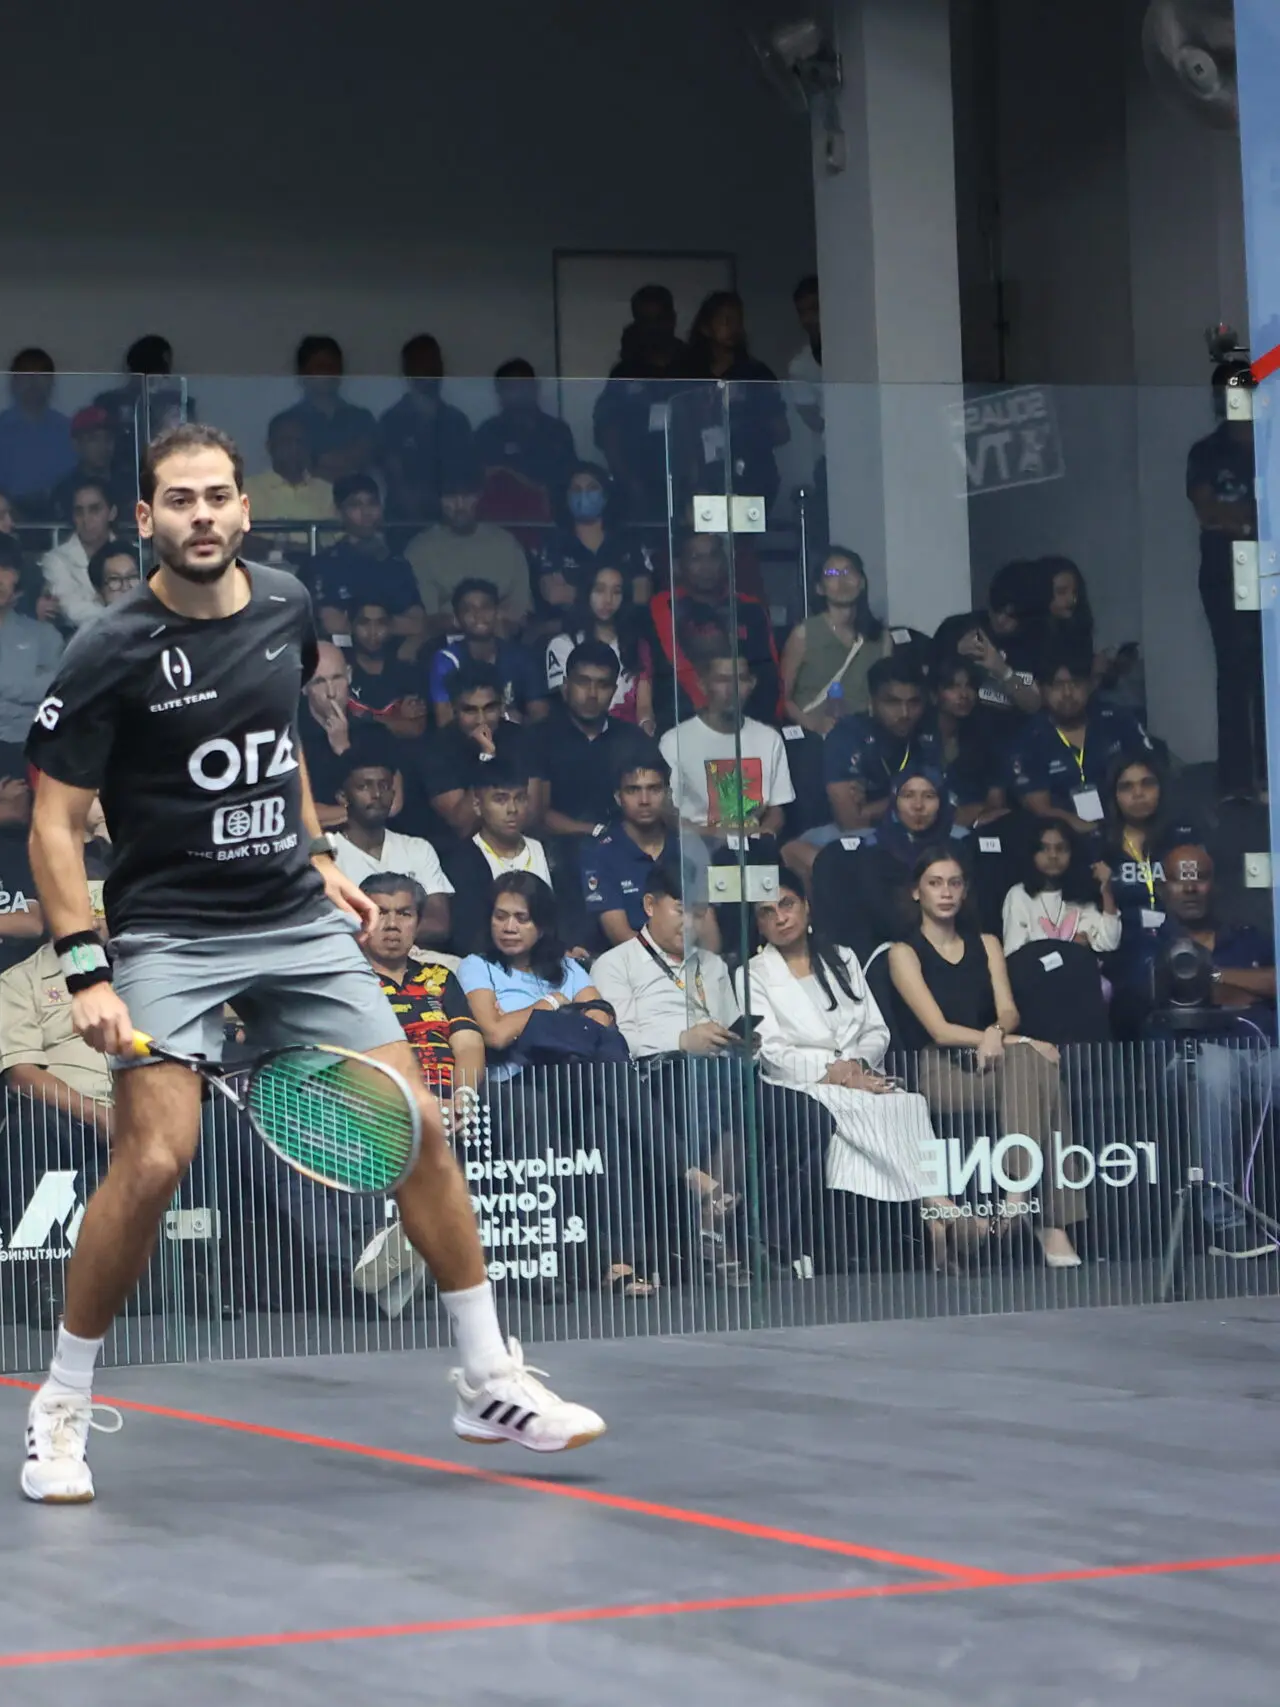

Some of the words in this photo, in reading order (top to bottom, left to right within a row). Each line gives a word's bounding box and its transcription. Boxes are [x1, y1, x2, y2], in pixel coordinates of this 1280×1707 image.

[150, 698, 183, 713] ELITE
[183, 690, 218, 705] TEAM
[186, 850, 213, 860] THE
[217, 845, 250, 861] BANK
[252, 843, 270, 855] TO
[272, 833, 298, 853] TRUST
